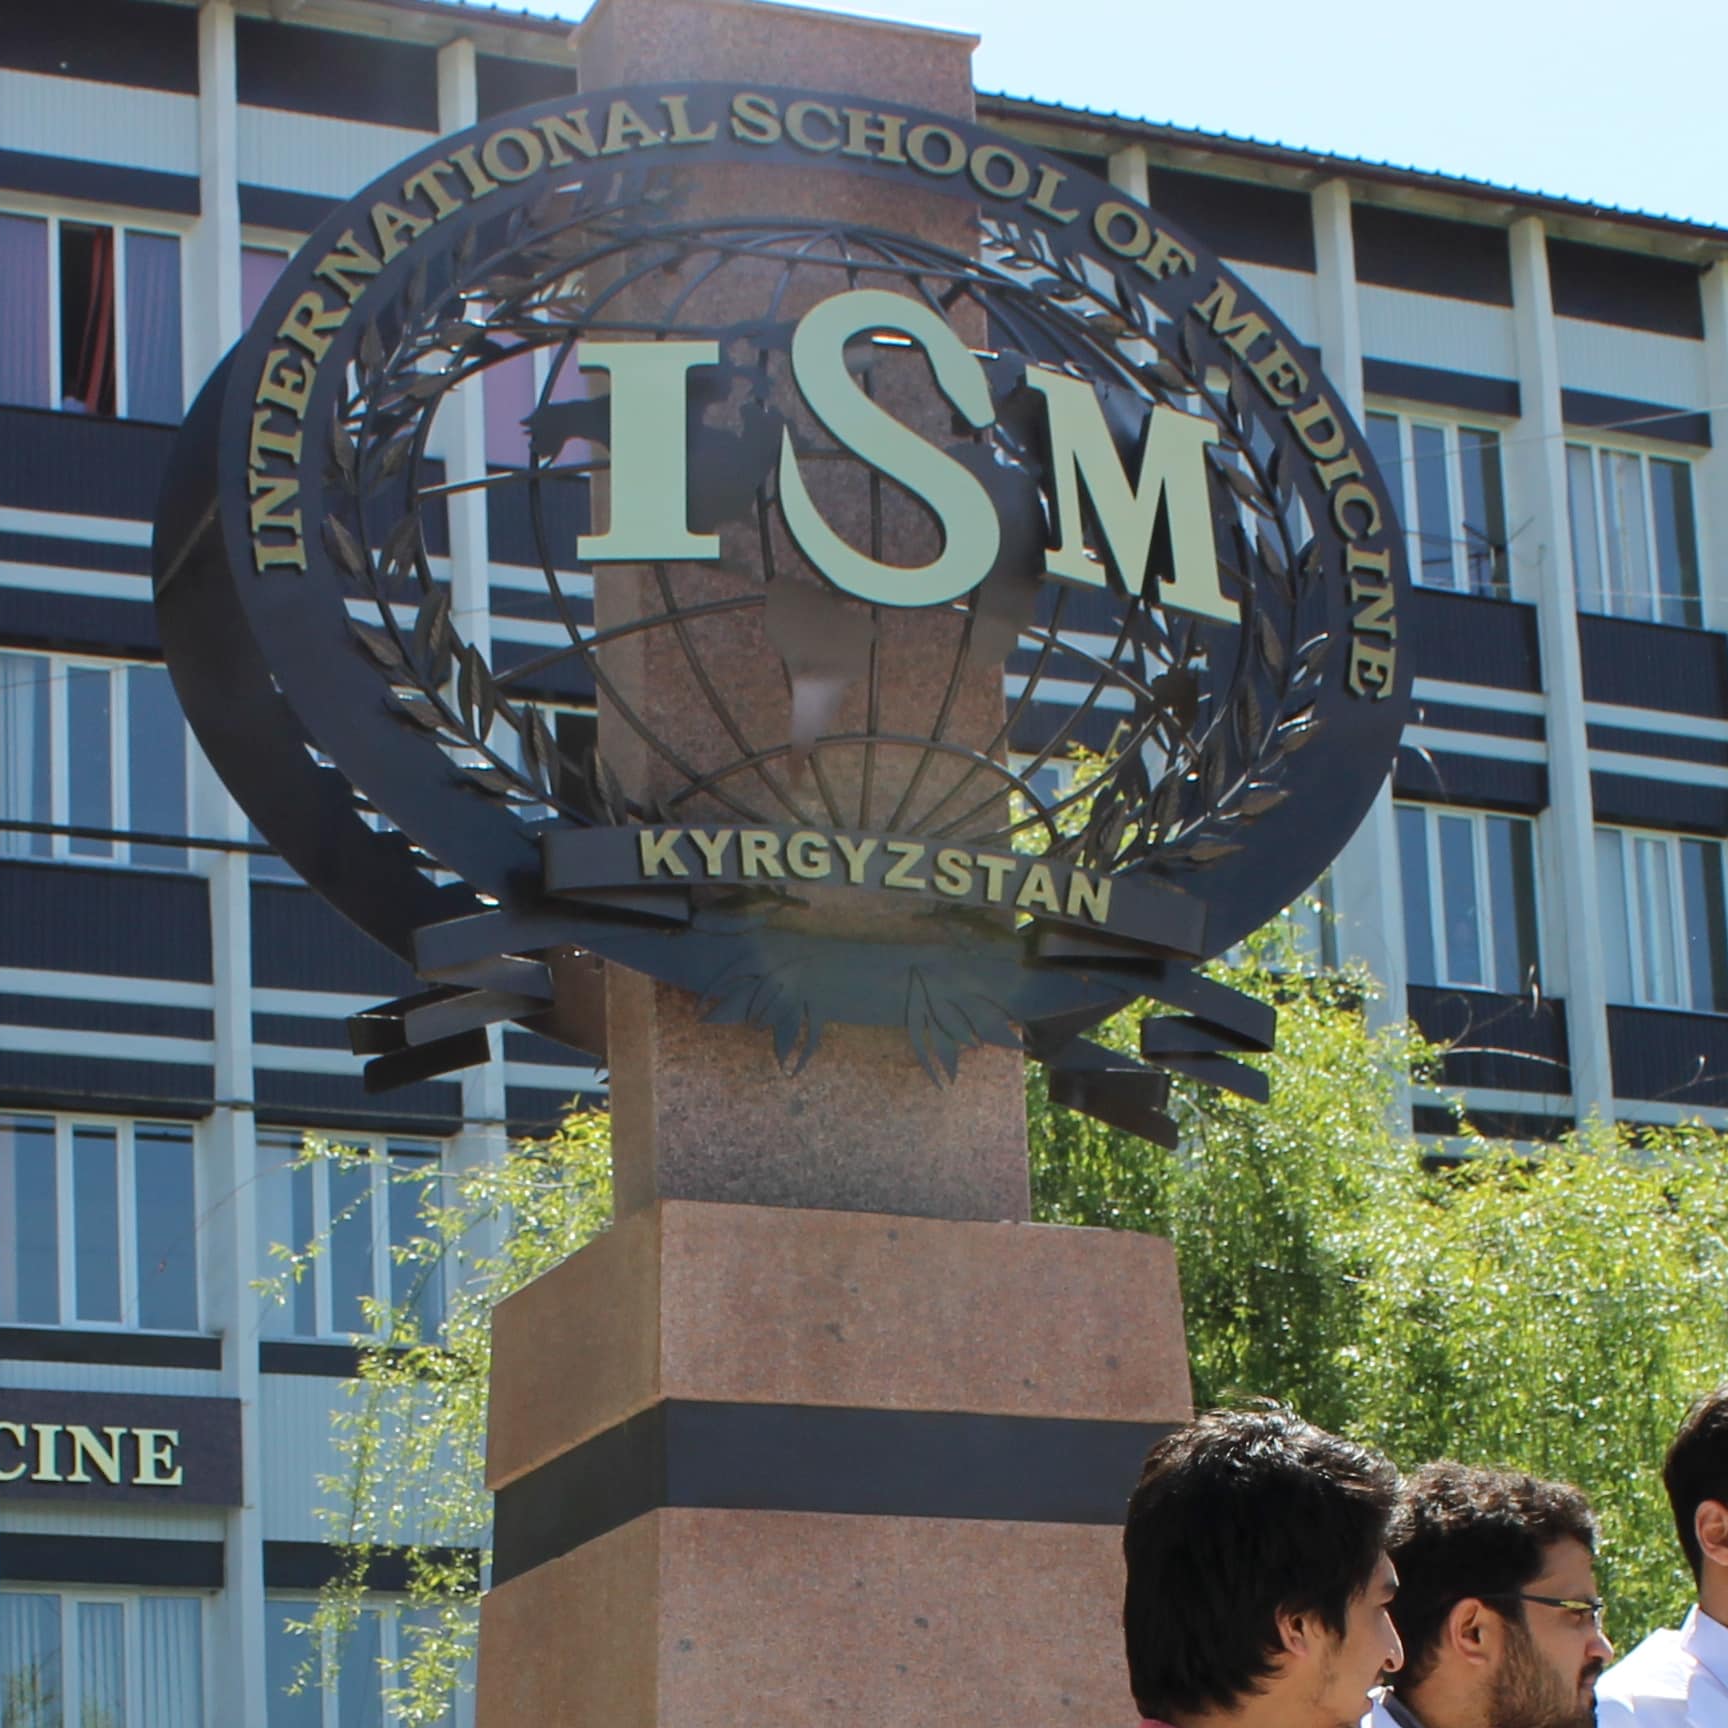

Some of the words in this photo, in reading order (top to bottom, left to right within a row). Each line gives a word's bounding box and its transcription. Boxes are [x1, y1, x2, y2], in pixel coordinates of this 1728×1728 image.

[246, 92, 719, 576] INTERNATIONAL
[728, 92, 1081, 227] SCHOOL
[1092, 200, 1197, 308] OF
[1191, 279, 1398, 702] MEDICINE
[576, 288, 1241, 623] ISM
[638, 827, 1114, 925] KYRGYZSTAN
